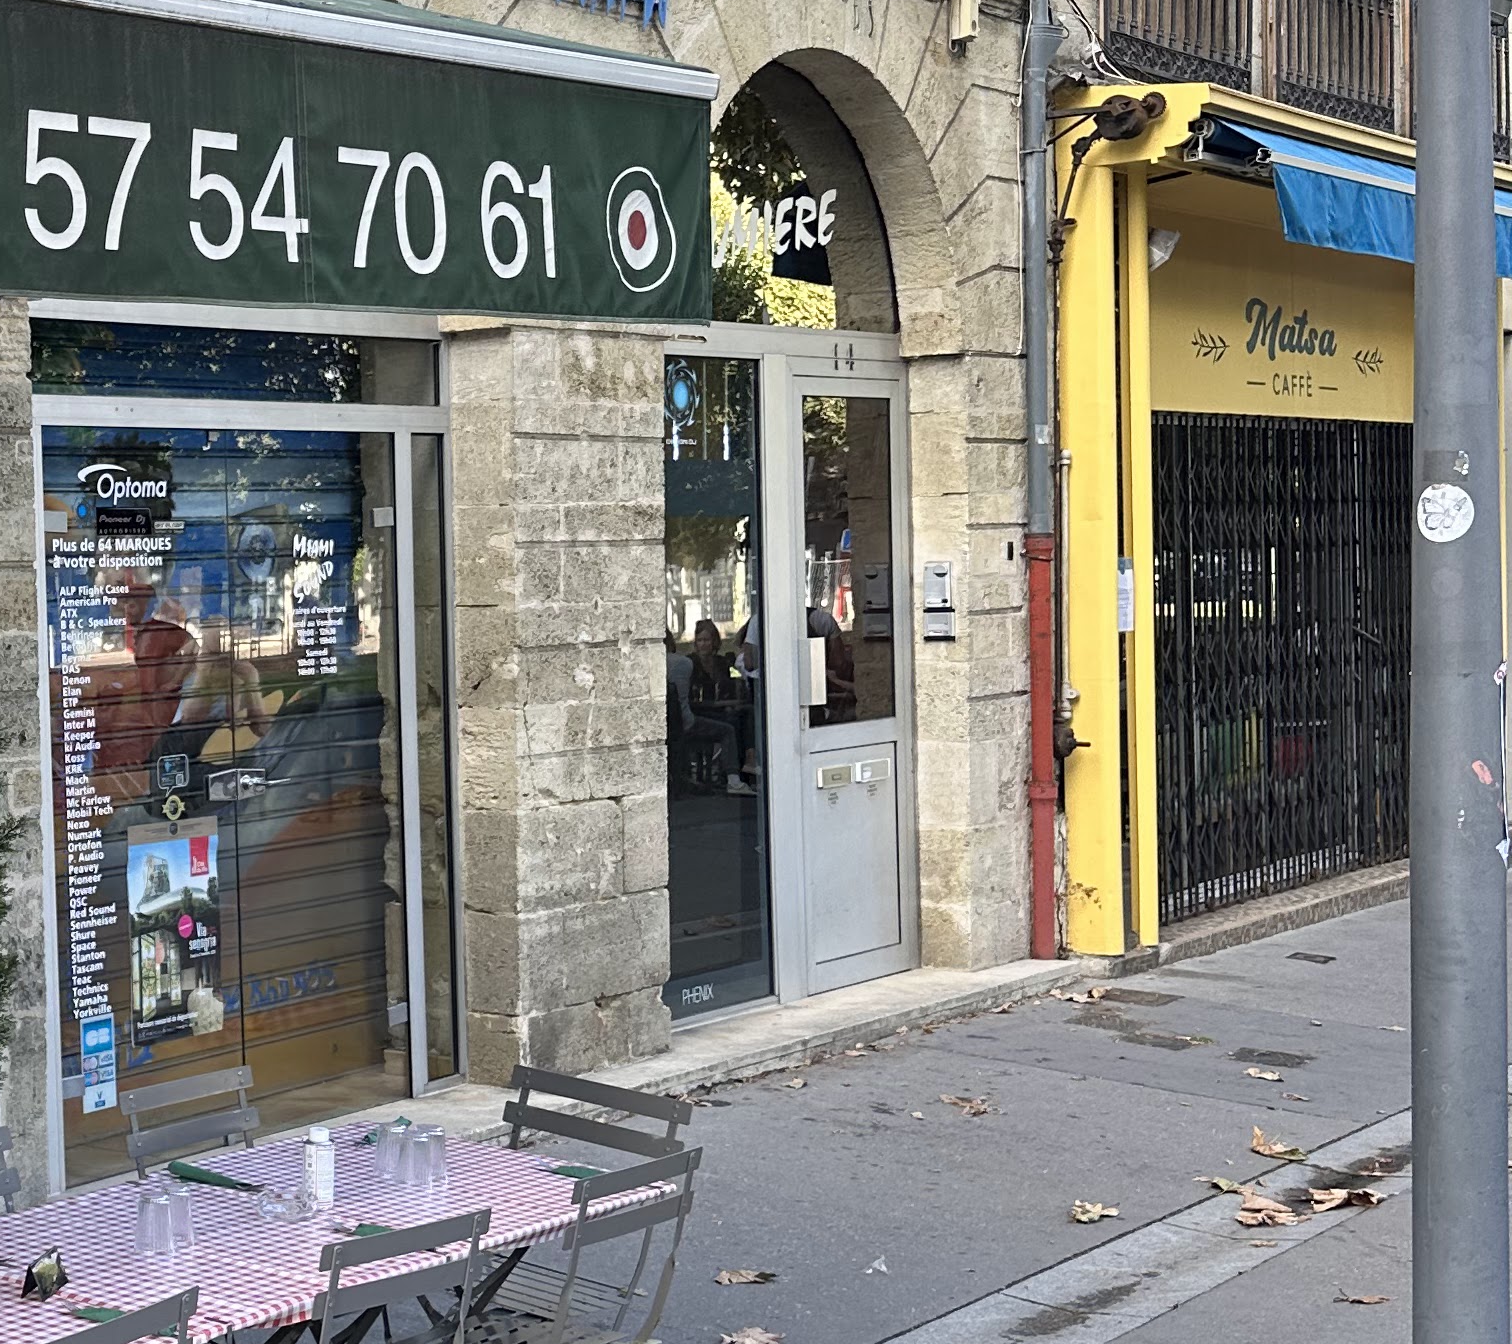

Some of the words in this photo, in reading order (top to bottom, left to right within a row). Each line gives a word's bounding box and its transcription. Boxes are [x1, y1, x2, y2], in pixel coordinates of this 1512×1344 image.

[24, 108, 151, 252] 57
[189, 127, 308, 263] 54
[337, 146, 447, 275] 70
[480, 159, 557, 279] 61
[1245, 297, 1337, 361] Matsa
[834, 342, 855, 371] 14
[1272, 370, 1313, 398] CAFFÈ
[97, 472, 167, 506] Optoma
[98, 514, 132, 523] Pioneer
[52, 538, 77, 552] Plus
[80, 538, 95, 552] de
[98, 538, 113, 552] 64
[115, 537, 172, 553] MARQUES
[293, 533, 334, 558] MIAMI
[64, 556, 96, 568] votre
[98, 553, 163, 570] disposition
[59, 586, 77, 596] ALP
[78, 585, 104, 597] Flight
[105, 585, 129, 595] Cases
[60, 597, 101, 608] American
[103, 596, 118, 606] Pro
[60, 608, 78, 619] ATX
[60, 620, 67, 630] B
[68, 619, 76, 629] &
[78, 619, 84, 629] C
[88, 616, 127, 629] Speakers
[61, 664, 80, 675] DAS
[62, 675, 91, 685] Denon
[62, 687, 82, 697] Elan
[62, 698, 79, 708] ETP
[63, 707, 95, 719] Gemini
[63, 720, 85, 731] Inter
[86, 718, 96, 728] M
[64, 730, 95, 742] Keeper
[74, 740, 101, 752] Audio
[64, 753, 85, 764] Koss
[65, 764, 83, 775] KRK
[65, 774, 89, 786] Mach
[66, 785, 95, 796] Martin
[66, 798, 79, 808] Mc
[81, 795, 111, 806] Farlow
[66, 807, 92, 820] Mobil
[93, 805, 113, 816] Tech
[67, 820, 90, 830] Nexo
[67, 828, 102, 841] Numark
[68, 840, 102, 852] Ortofon
[78, 851, 105, 862] Audio
[68, 864, 99, 875] Peavey
[68, 873, 103, 886] Pioneer
[69, 886, 97, 897] Power
[69, 896, 88, 910] QSC
[70, 908, 87, 920] Red
[88, 902, 116, 917] Sound
[70, 916, 118, 931] Sennheiser
[71, 930, 96, 942] Shure
[71, 941, 97, 954] Space
[71, 951, 106, 964] Stanton
[72, 962, 104, 975] Tascam
[72, 975, 92, 986] Teac
[72, 982, 109, 998] Technics
[72, 994, 108, 1009] Yamaha
[73, 1004, 112, 1019] Yorkville
